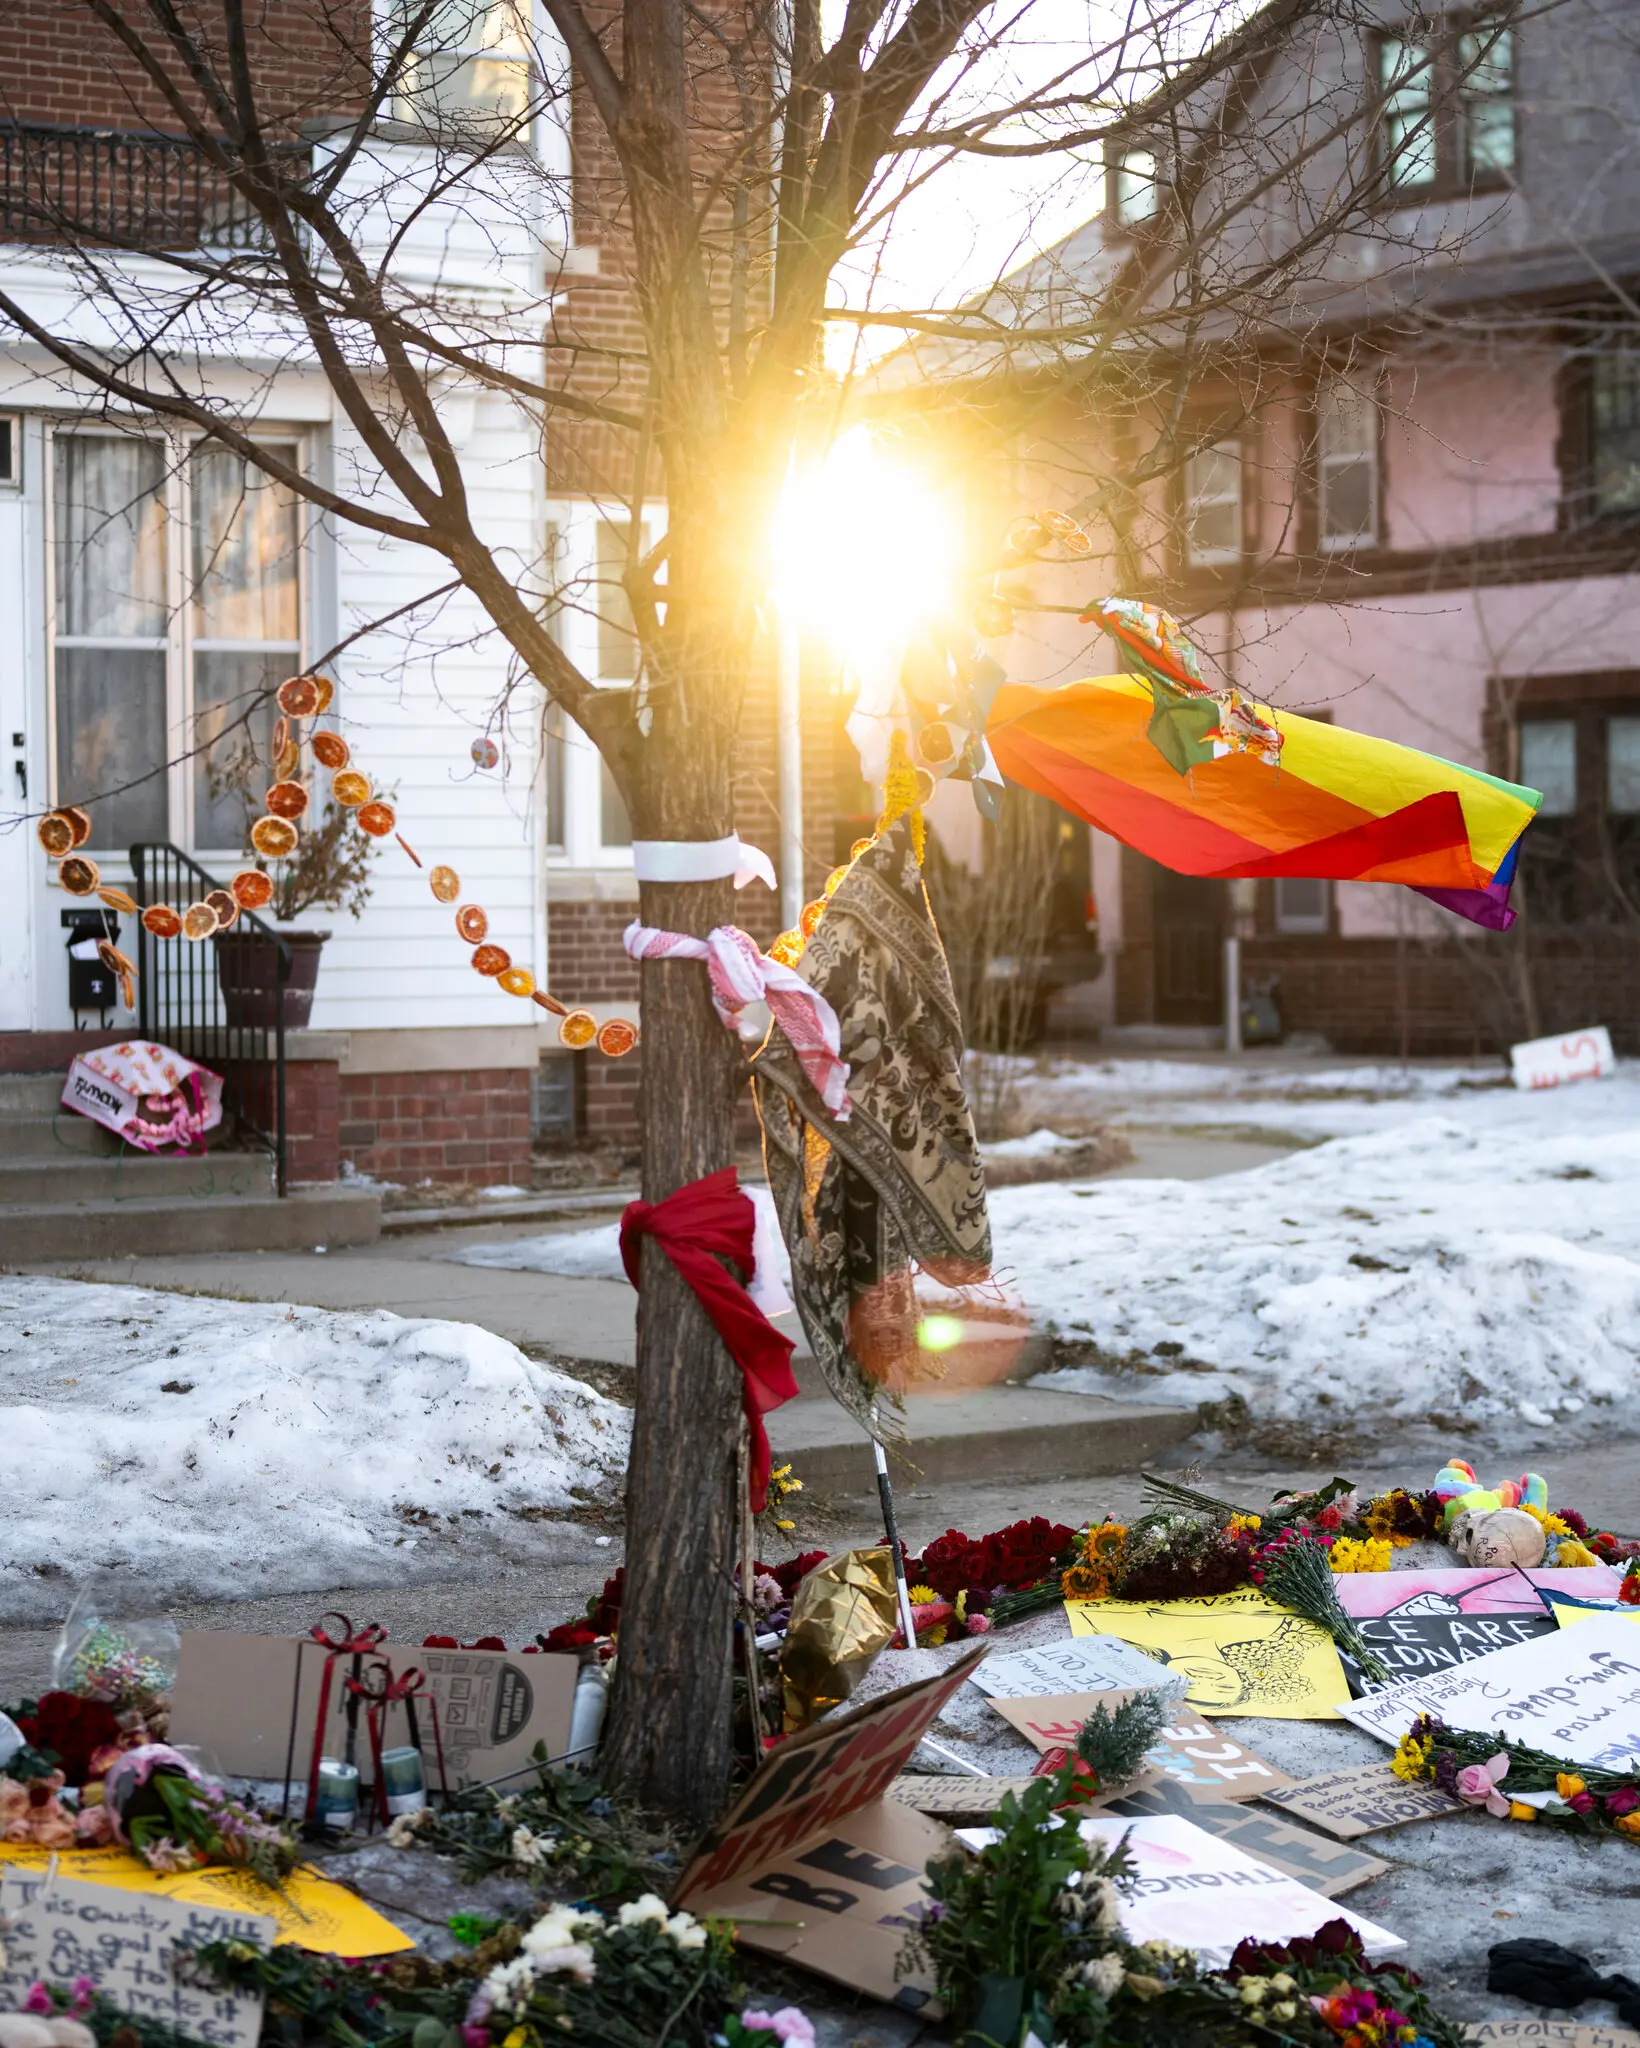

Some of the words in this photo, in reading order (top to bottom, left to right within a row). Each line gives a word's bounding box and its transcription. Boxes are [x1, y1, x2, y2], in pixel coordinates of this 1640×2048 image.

[1356, 1619, 1428, 1642] CE
[1037, 1650, 1086, 1672] OUT
[1431, 1675, 1511, 1700] Renee
[1490, 1686, 1580, 1723] dude
[1550, 1706, 1617, 1742] mad
[1161, 1723, 1274, 1780] ICE
[1262, 1774, 1358, 1803] Enquanto
[1361, 1771, 1378, 1779] a
[1326, 1806, 1355, 1819] que
[1351, 1802, 1421, 1829] NÃO
[750, 1838, 922, 1914] BE
[8, 1880, 74, 1915] Tis
[188, 1911, 263, 1940] WILL
[52, 1926, 79, 1945] a
[123, 1958, 167, 1984] to
[213, 1996, 242, 2022] it
[1476, 2021, 1576, 2040] ABOLI
